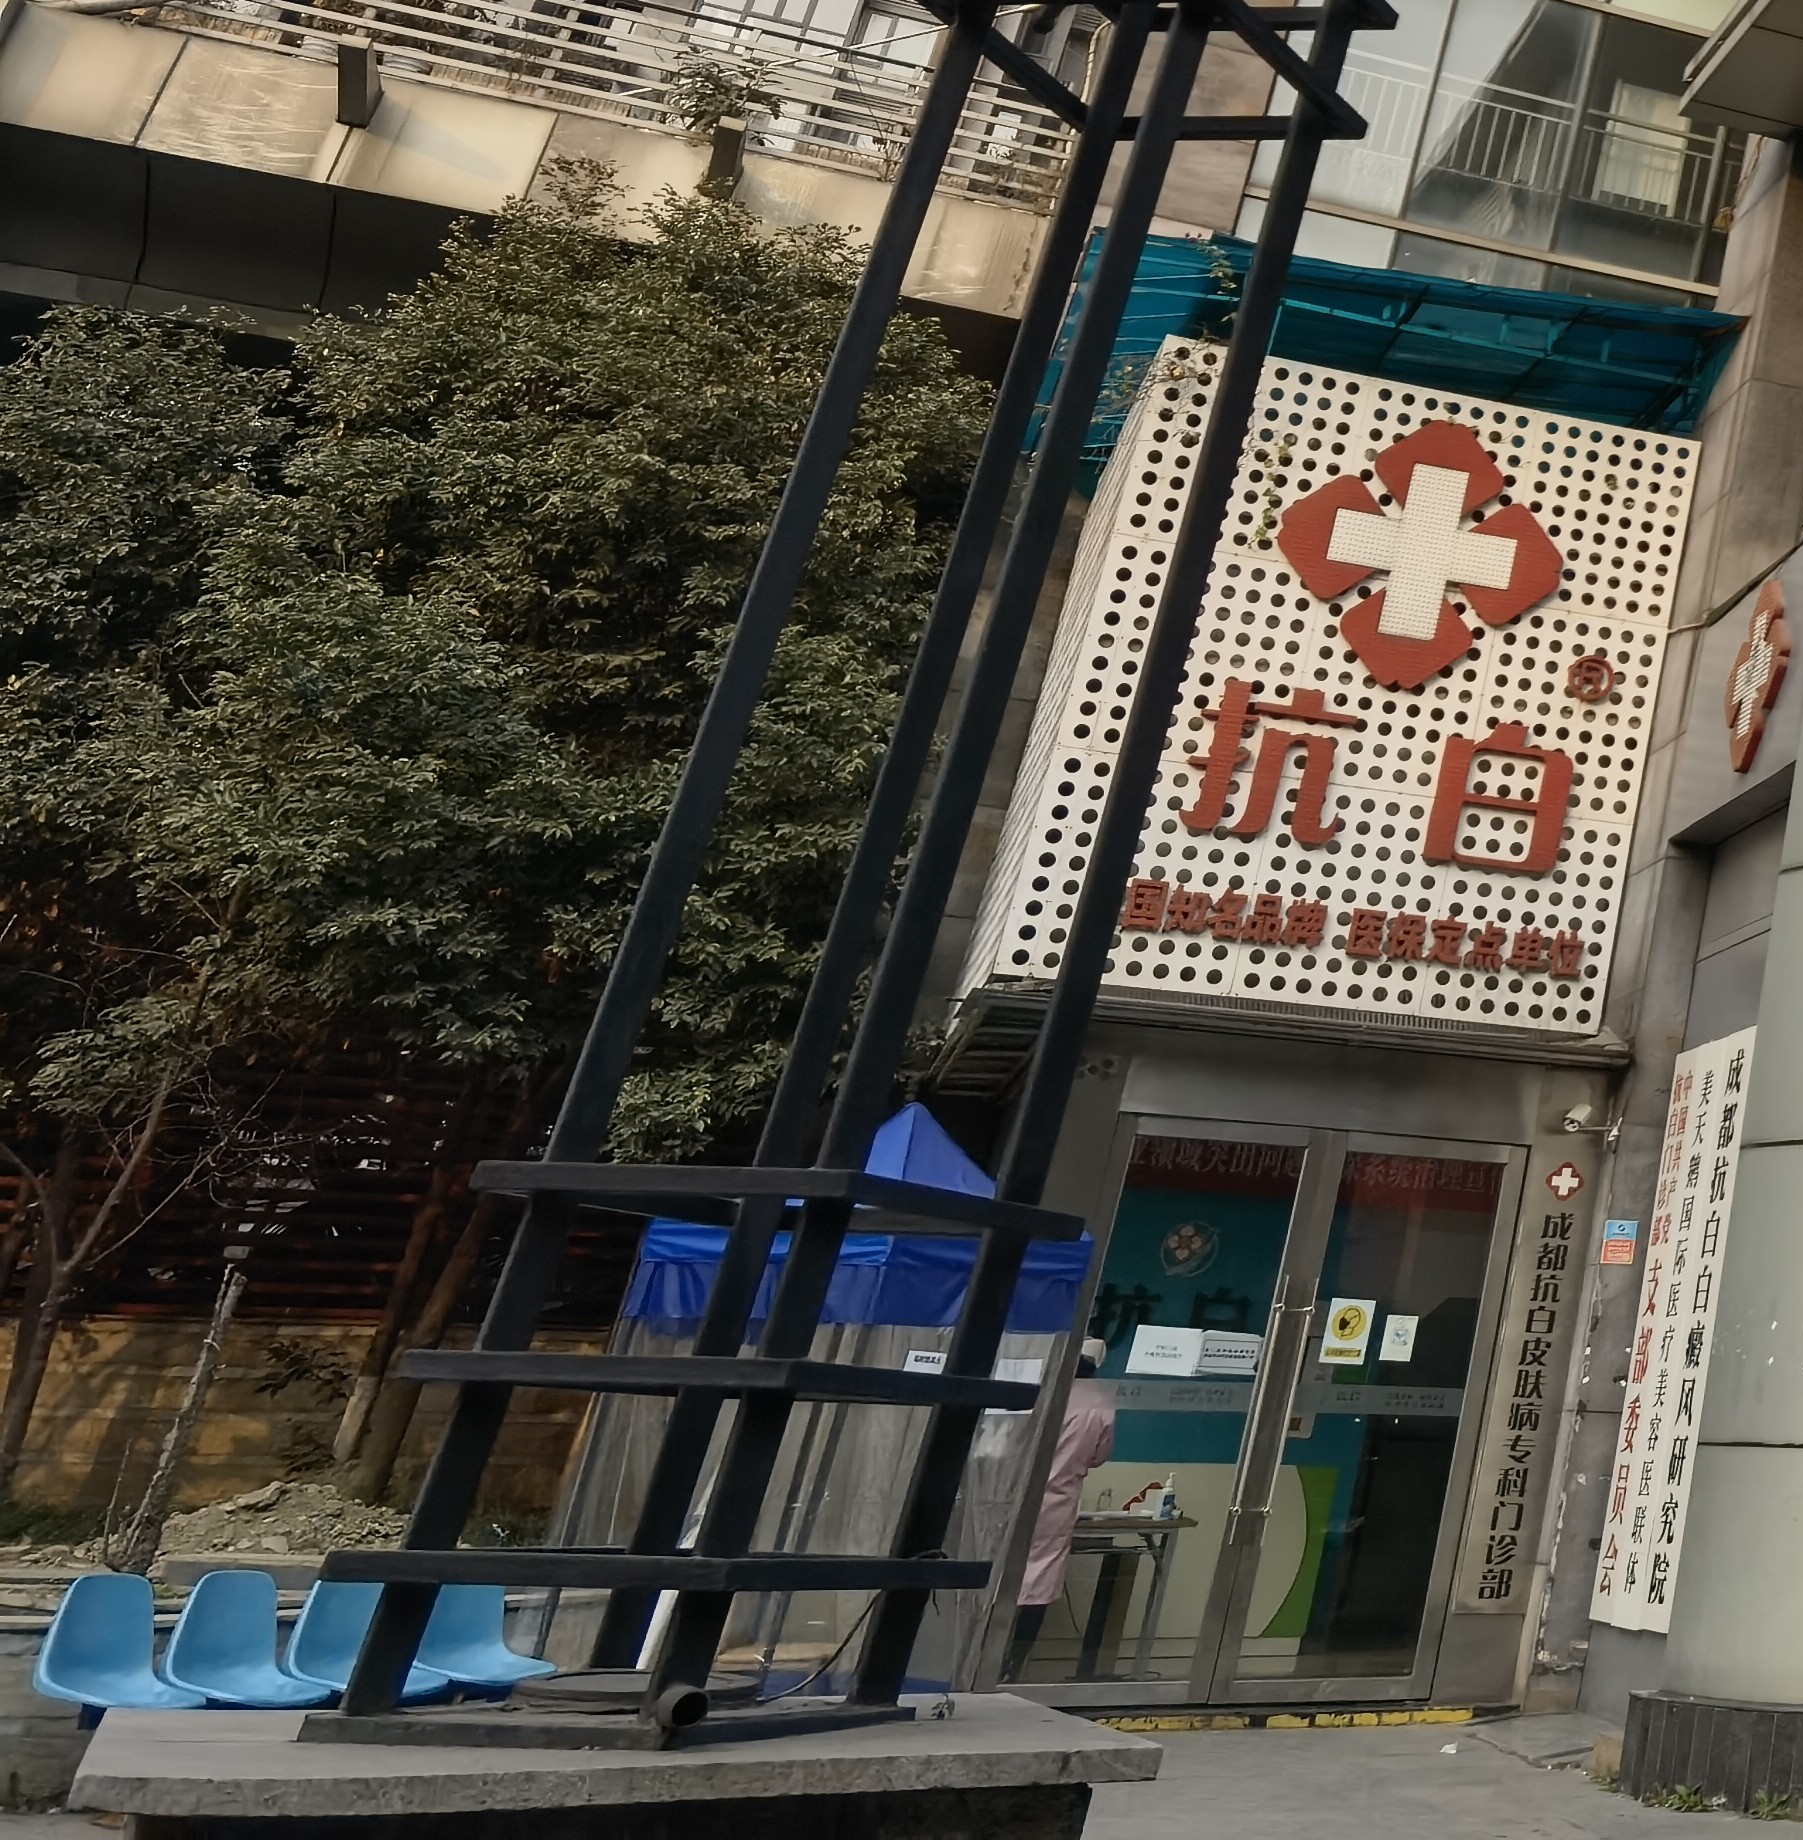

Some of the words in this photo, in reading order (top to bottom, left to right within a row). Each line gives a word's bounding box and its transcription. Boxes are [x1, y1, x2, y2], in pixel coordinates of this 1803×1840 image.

[1119, 877, 1329, 948] 国知名品牌
[1345, 907, 1586, 981] 医保定点单位
[1178, 678, 1576, 874] 抗白
[1476, 1211, 1575, 1602] 成都抗白皮肤病专科门诊部
[1598, 1257, 1664, 1598] 支部委员会
[1647, 1047, 1745, 1605] 成都抗白白癜风研究院
